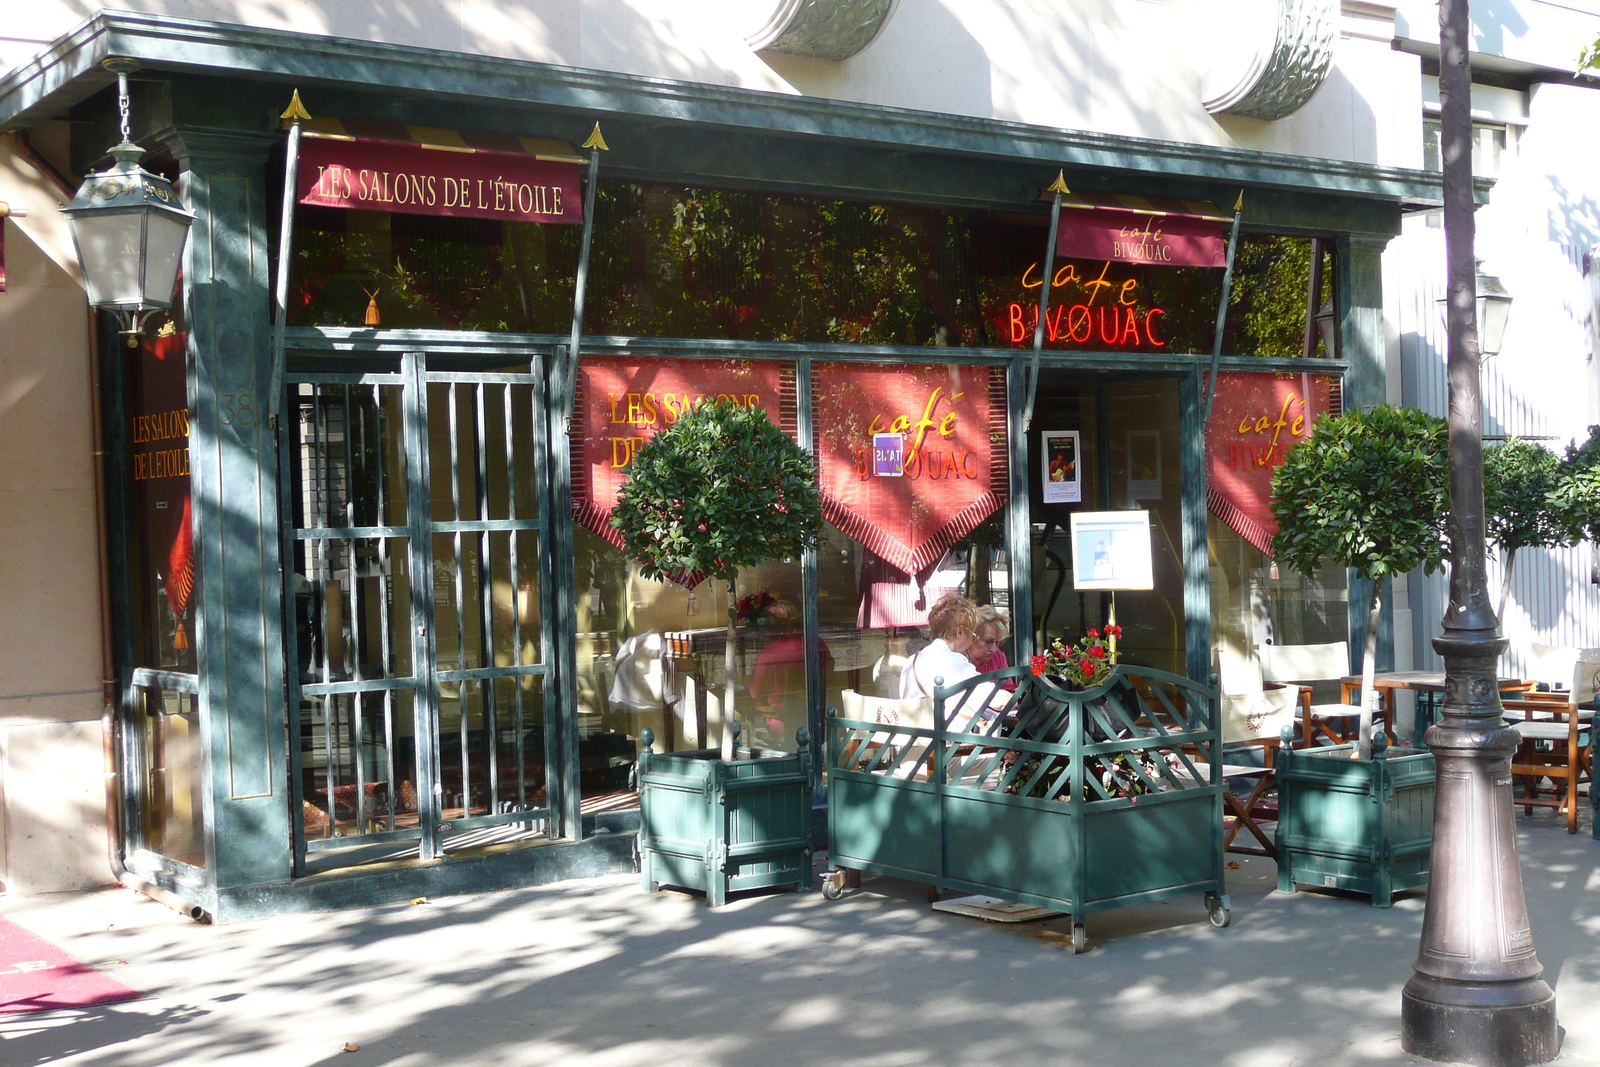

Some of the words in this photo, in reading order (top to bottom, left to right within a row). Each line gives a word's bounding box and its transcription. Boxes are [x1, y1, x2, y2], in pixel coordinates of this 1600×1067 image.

[317, 165, 352, 200] LES
[358, 168, 437, 207] SALONS
[443, 177, 472, 209] DE
[477, 175, 565, 216] L'ÉTOILE
[1113, 241, 1172, 262] BIVOUAC
[1119, 215, 1165, 257] café
[1010, 303, 1165, 346] BIVOUAC
[218, 393, 255, 425] 38
[609, 392, 658, 424] LES
[133, 414, 150, 443] LES
[151, 408, 190, 442] SALONS
[868, 386, 964, 471] café
[1238, 392, 1310, 466] café
[134, 453, 148, 481] DE
[855, 445, 976, 477] BIVOUAC
[1229, 442, 1292, 469] BIVO
